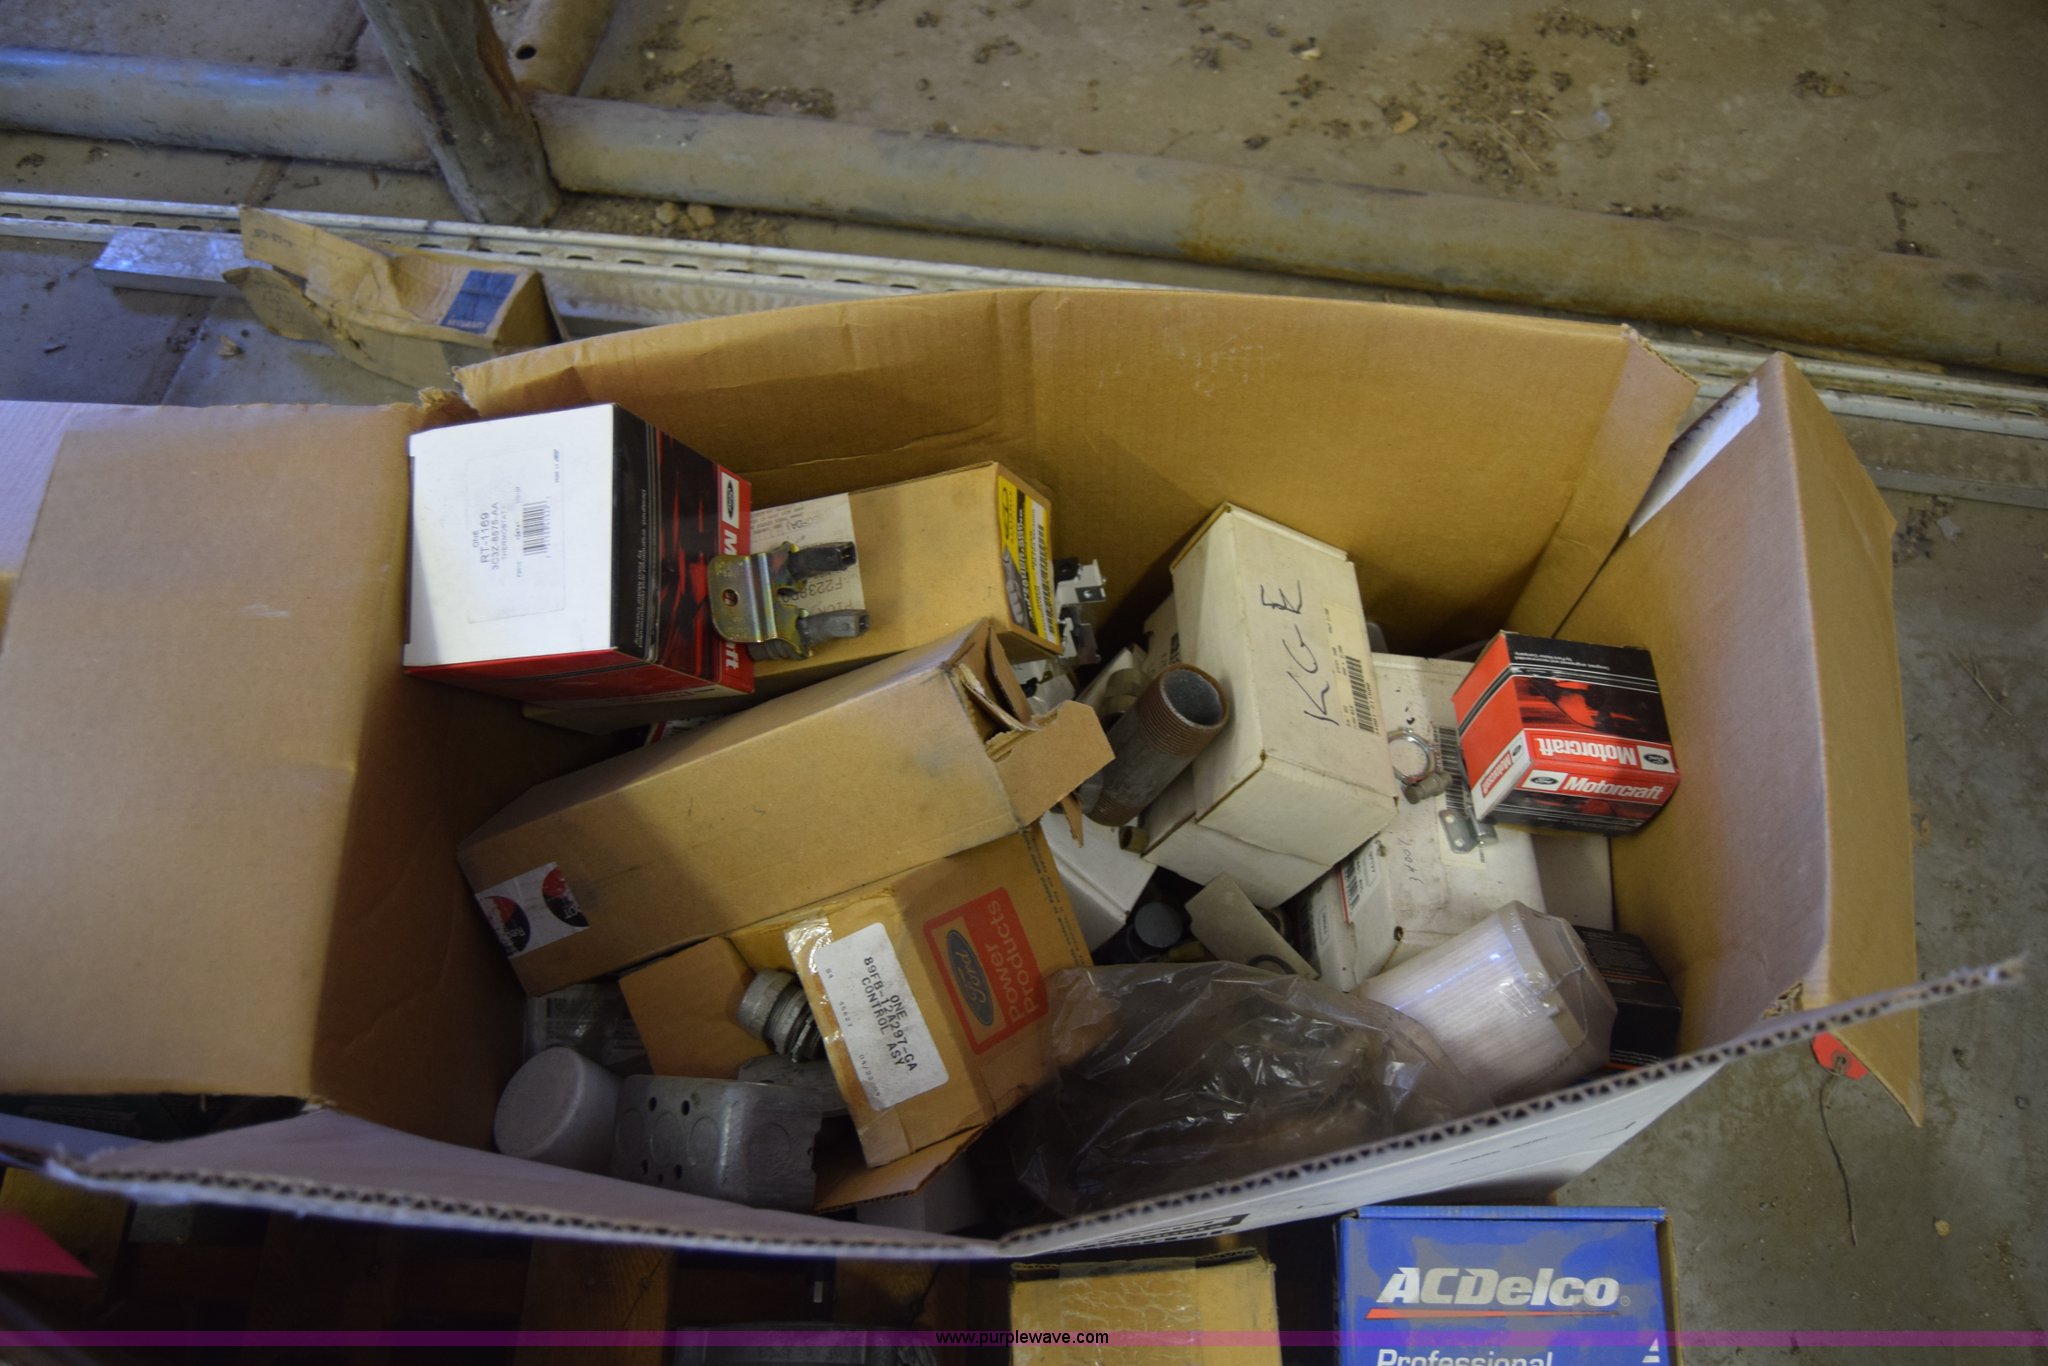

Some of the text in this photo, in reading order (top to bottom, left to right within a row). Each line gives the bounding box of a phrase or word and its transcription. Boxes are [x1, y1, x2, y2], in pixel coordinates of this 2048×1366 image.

[472, 530, 480, 548] ONE
[480, 512, 490, 563] RT-1169
[1536, 737, 1638, 766] Motorcraft
[1563, 776, 1664, 800] Motorcraft
[952, 943, 990, 1009] Ford
[988, 900, 1040, 1014] Products
[986, 943, 1025, 1022] Power
[861, 977, 906, 1066] CONTROL ASY
[864, 956, 918, 1071] 89FB-12A297-GA
[890, 995, 908, 1019] ONE
[1376, 1267, 1620, 1307] ACDelco
[1377, 1348, 1554, 1366] Professional
